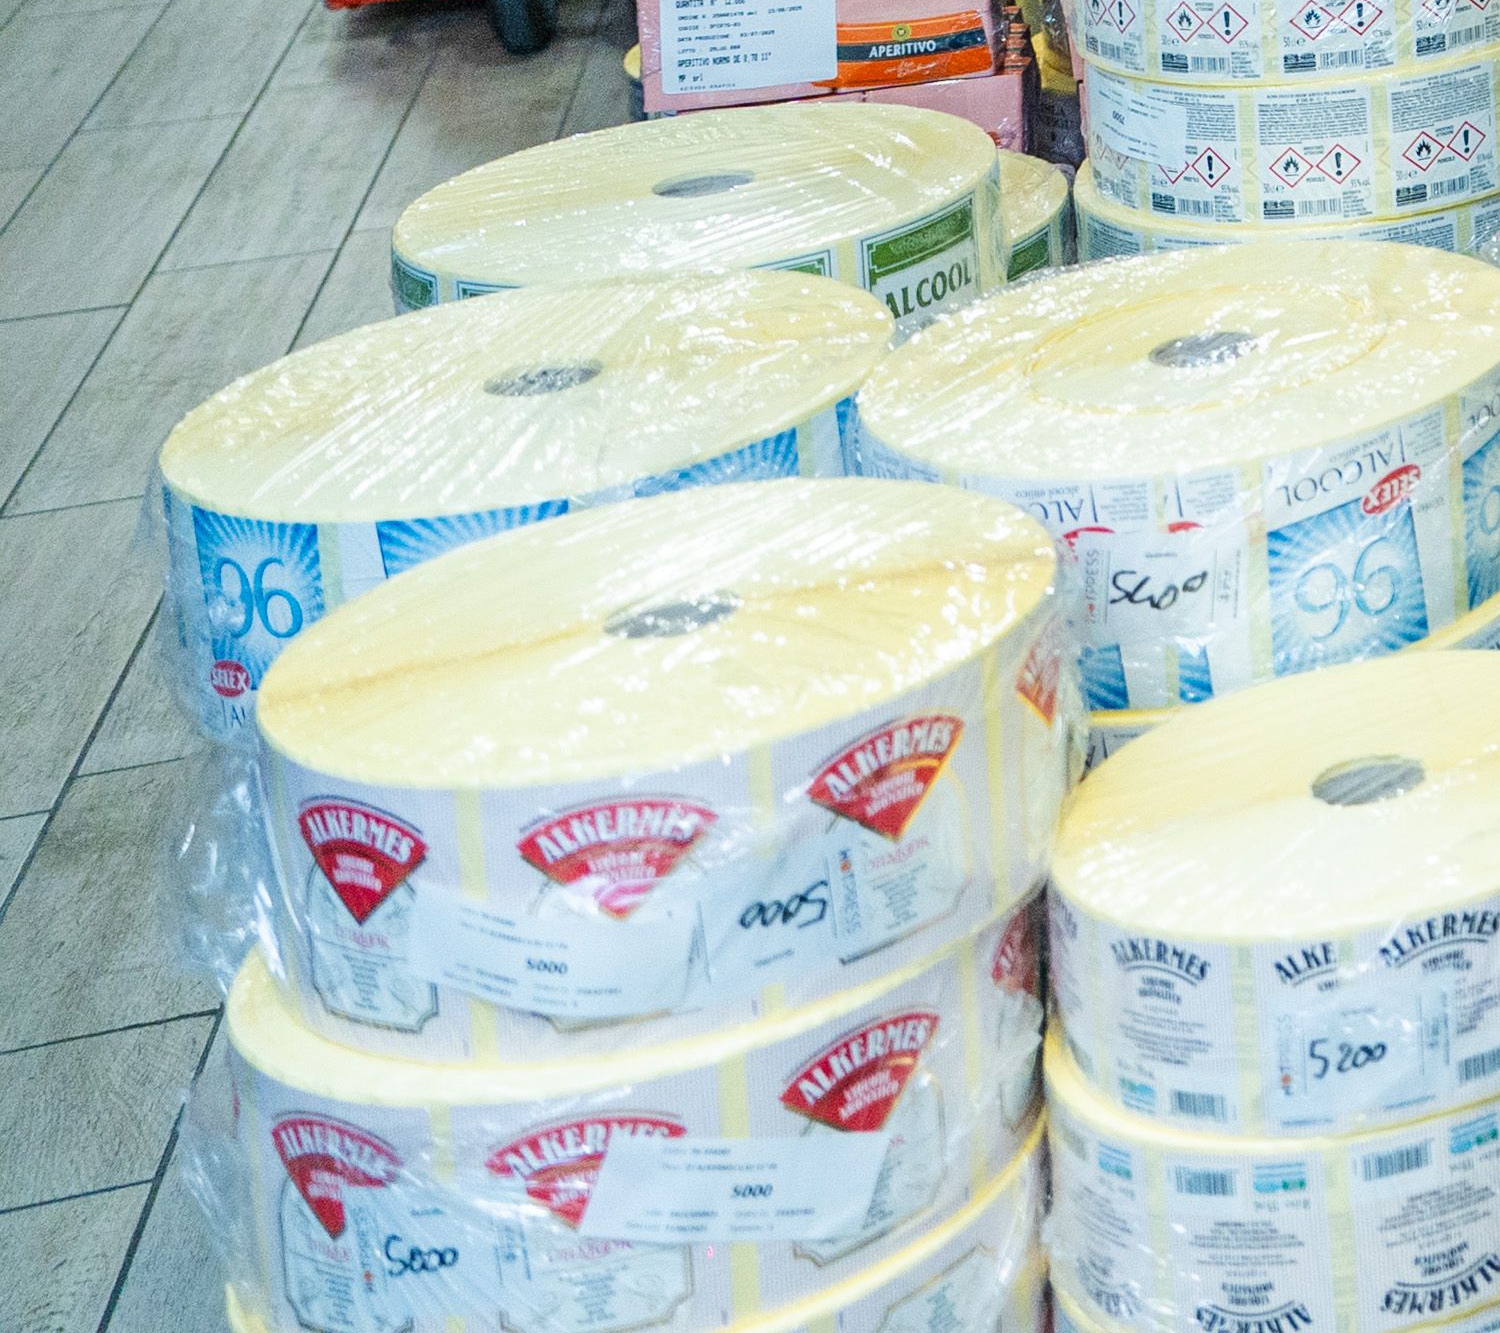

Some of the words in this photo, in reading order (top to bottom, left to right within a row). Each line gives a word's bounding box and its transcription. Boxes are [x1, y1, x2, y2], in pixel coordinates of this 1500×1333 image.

[677, 57, 711, 67] APERITIVO
[712, 55, 732, 66] NORMA
[868, 39, 937, 59] APERITIVO
[884, 256, 973, 321] ALCOOL
[1279, 436, 1394, 507] ALCOOL
[1362, 465, 1421, 513] SELEX
[214, 556, 304, 639] 96
[1294, 535, 1401, 641] 96
[211, 666, 250, 691] SELEX
[825, 721, 952, 798] ALKERMES
[307, 808, 416, 865] ALKERMES
[533, 809, 700, 863] ALKERMES
[524, 957, 568, 974] 5000
[1111, 938, 1213, 987] ALKERMES
[798, 1019, 936, 1109] ALKERMES
[731, 1183, 775, 1200] 5000
